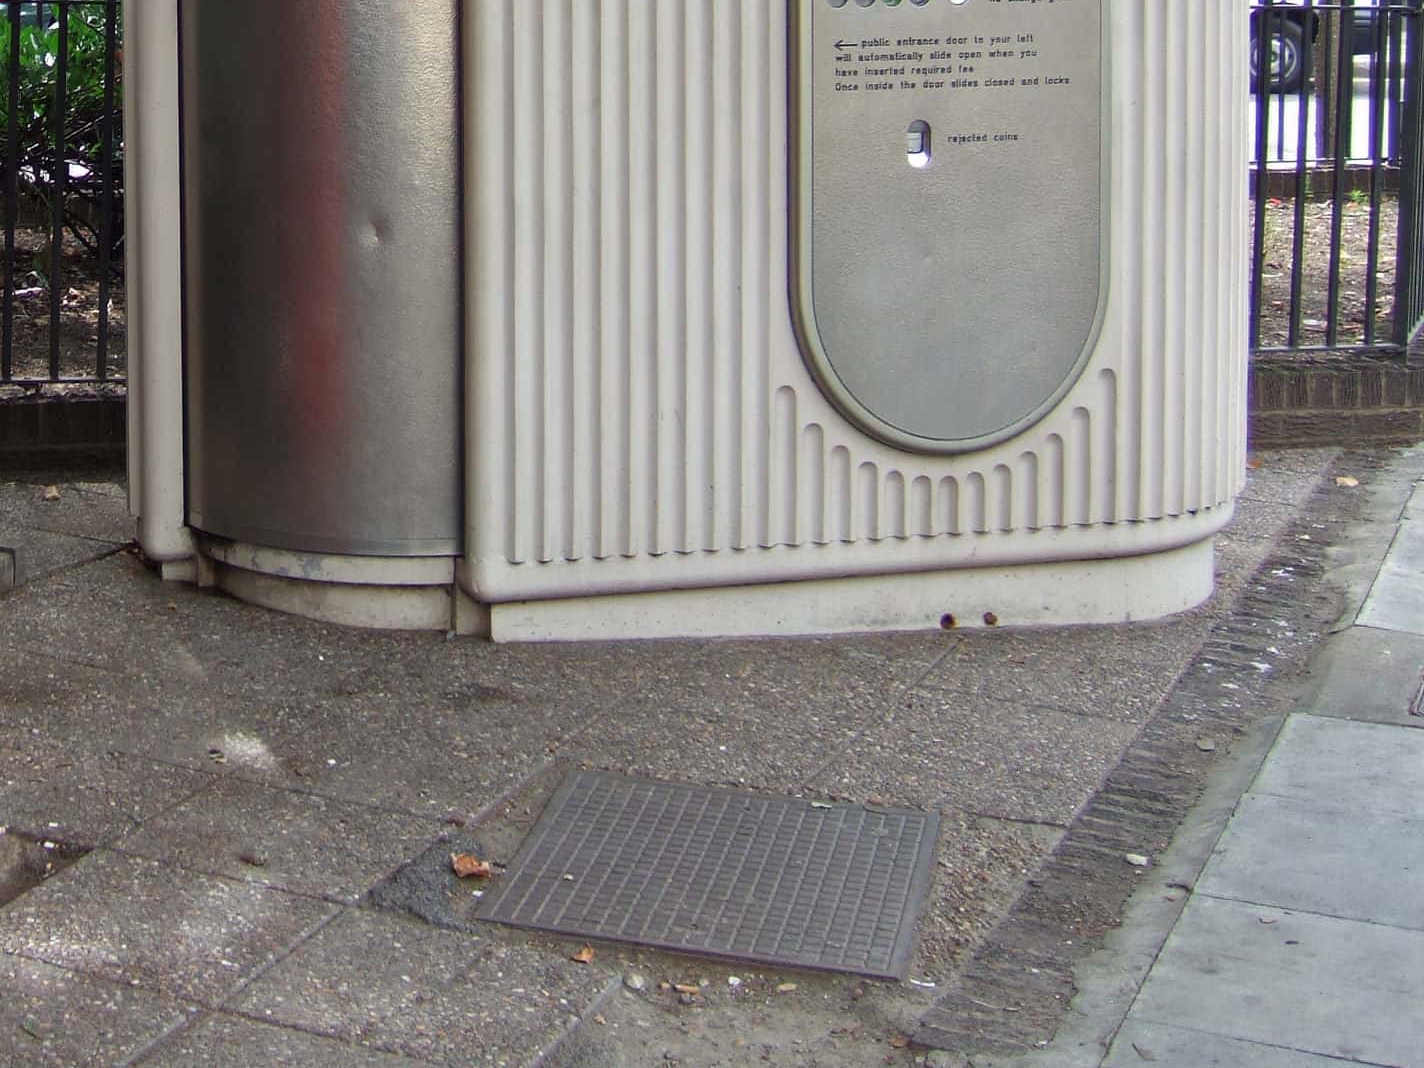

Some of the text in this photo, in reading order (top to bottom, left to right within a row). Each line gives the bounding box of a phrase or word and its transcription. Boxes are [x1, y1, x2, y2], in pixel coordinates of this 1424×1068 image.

[861, 34, 1033, 49] public entrance door to your left
[836, 49, 1037, 62] will automatically slide open when you
[835, 68, 858, 76] have
[865, 66, 904, 76] inserted
[911, 65, 952, 76] required
[835, 76, 1069, 91] Once inside the door slides closed and locks
[948, 132, 1018, 145] rejected coins
